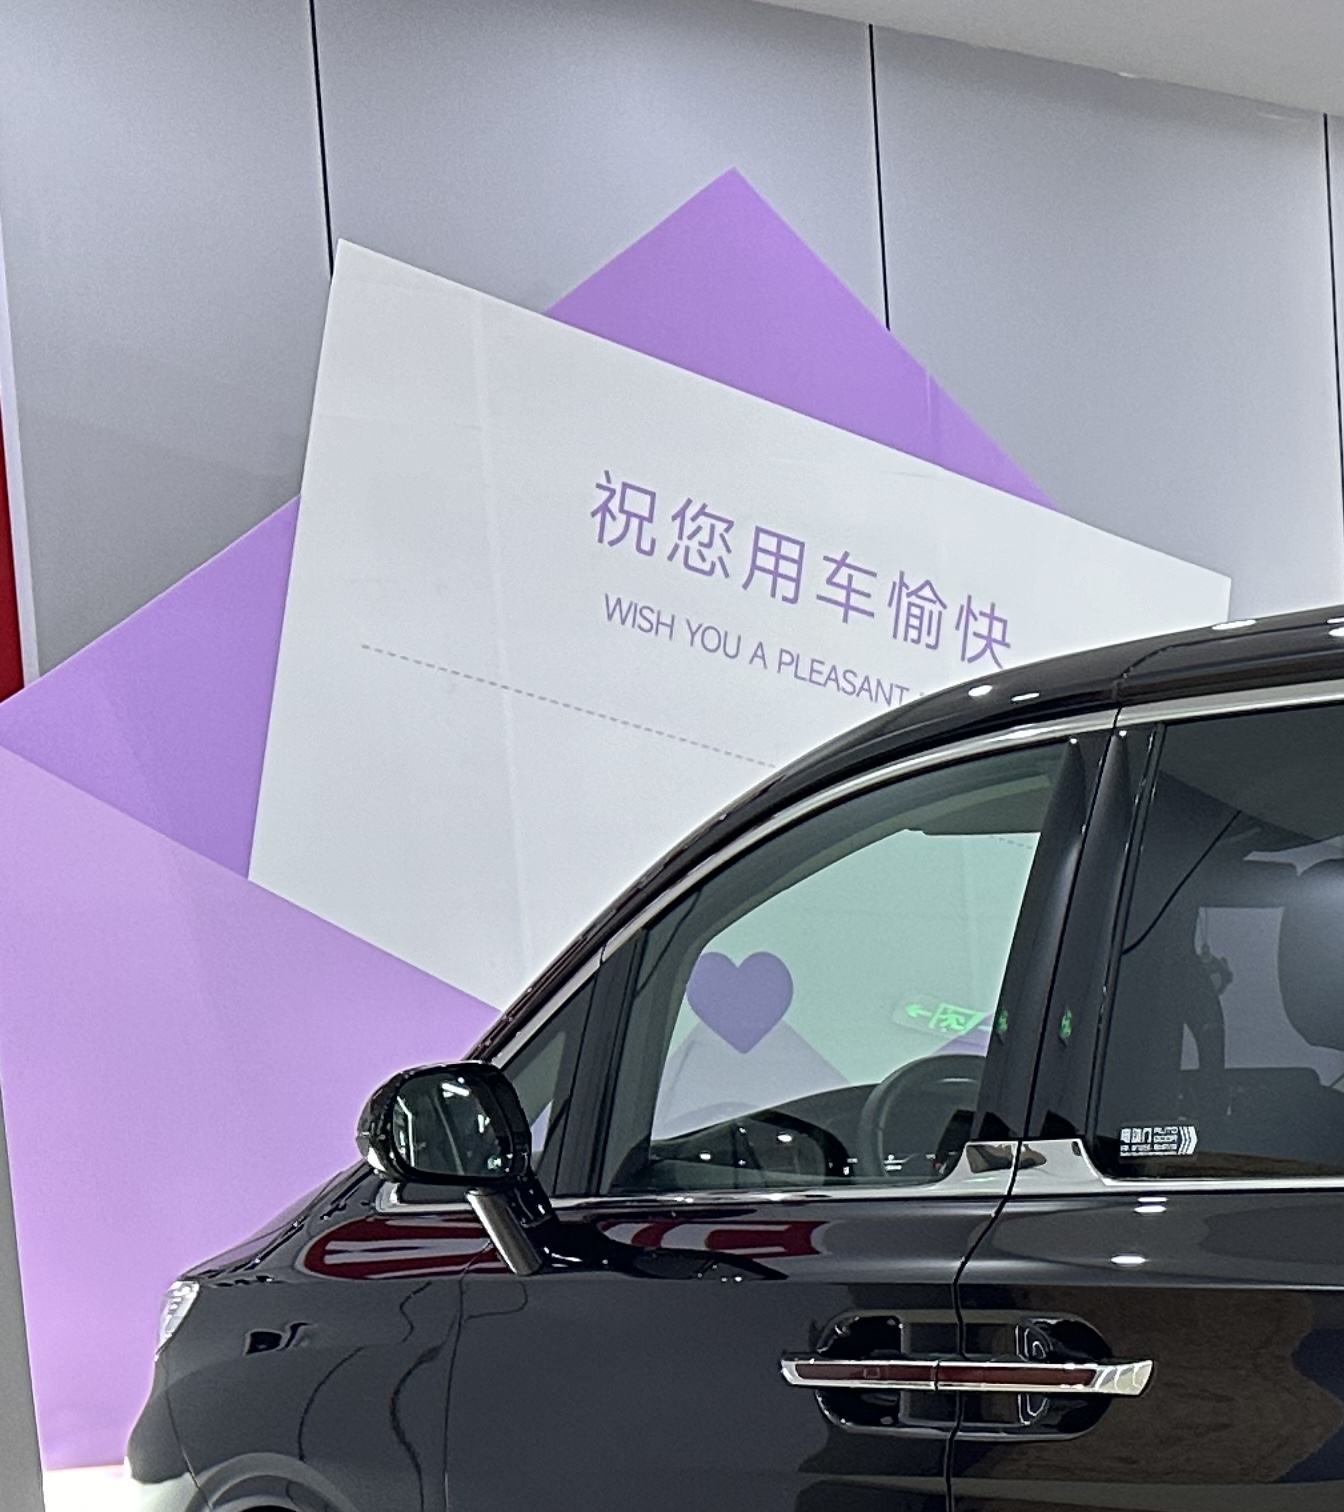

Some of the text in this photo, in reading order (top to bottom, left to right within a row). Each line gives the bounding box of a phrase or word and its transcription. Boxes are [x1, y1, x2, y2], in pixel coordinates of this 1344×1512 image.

[589, 470, 1012, 670] 祝您用车愉快
[604, 593, 911, 708] WISH YOU A PLEASANT
